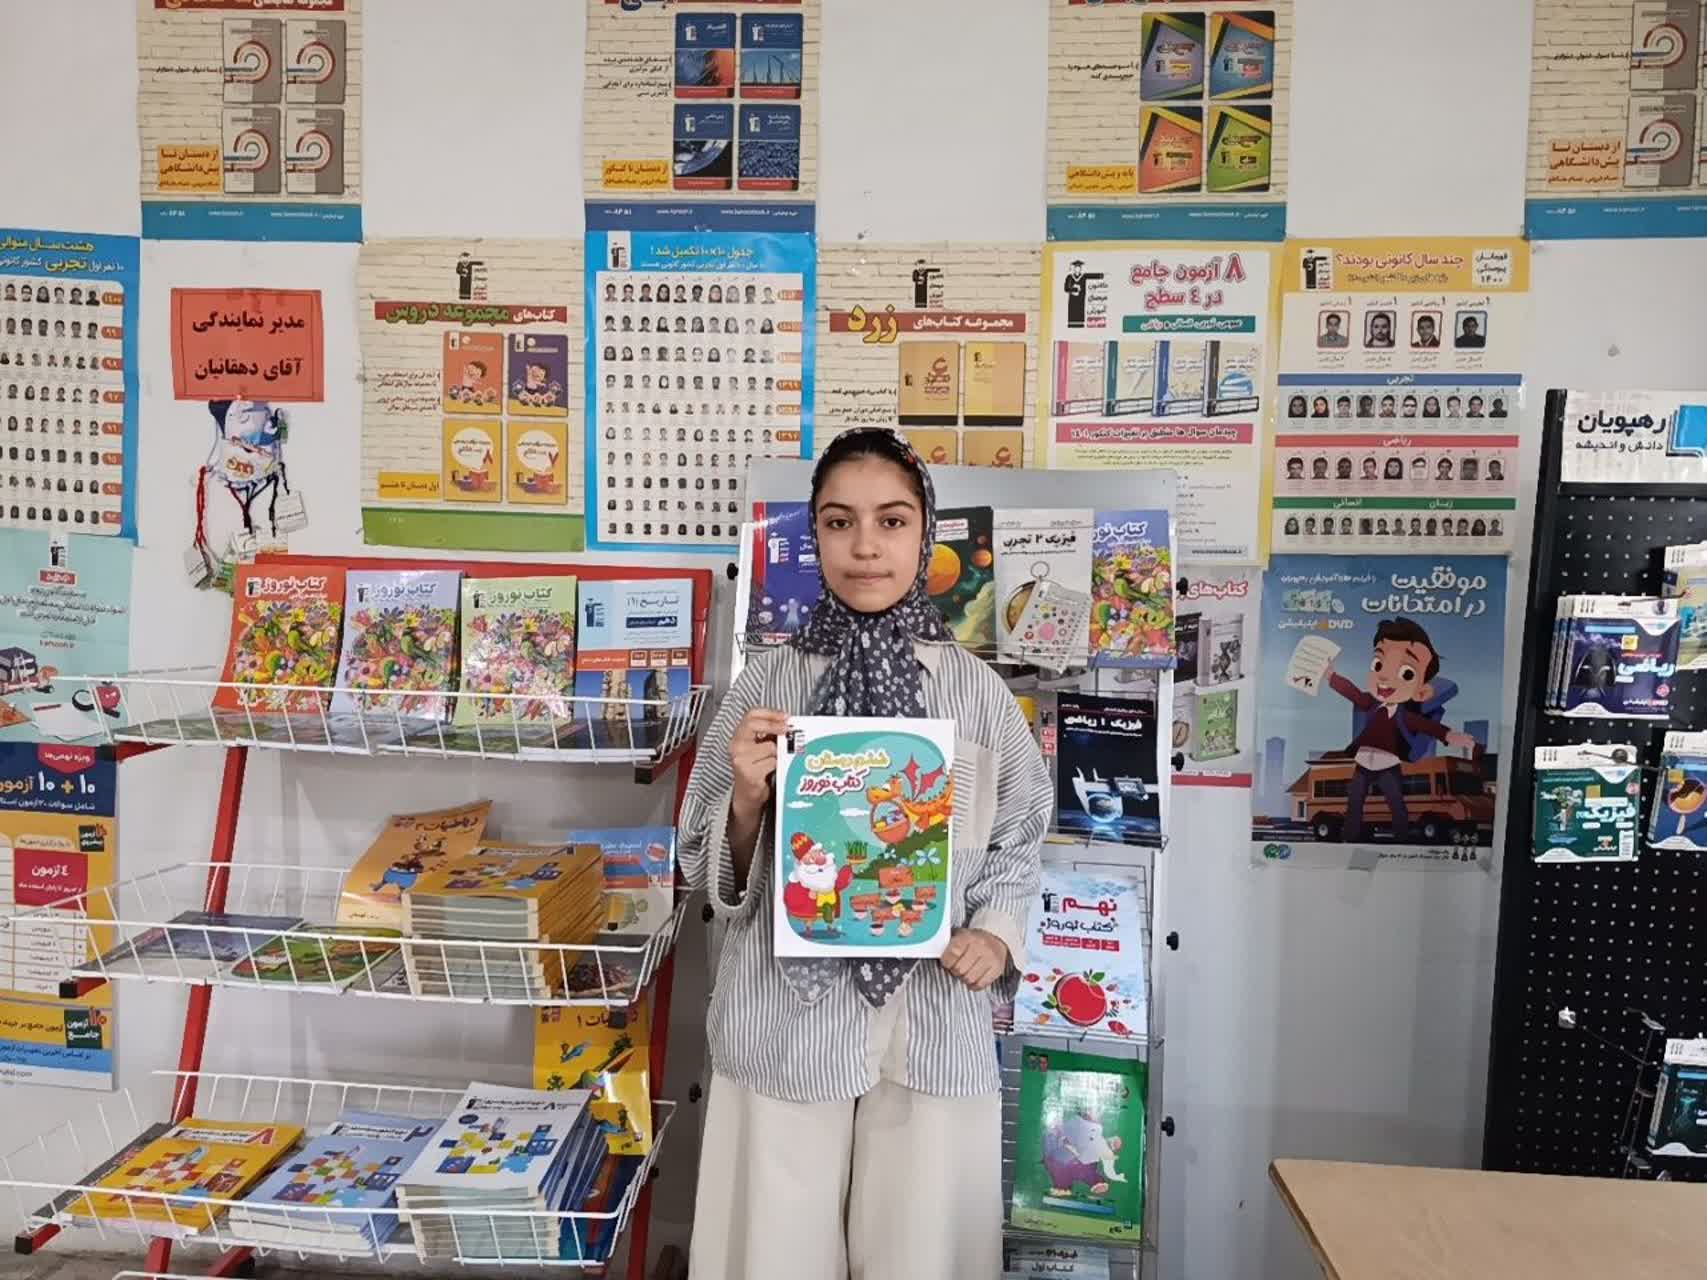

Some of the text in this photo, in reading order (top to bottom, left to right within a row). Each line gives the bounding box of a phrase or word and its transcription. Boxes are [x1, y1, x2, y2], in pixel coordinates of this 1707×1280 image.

[1415, 251, 1440, 269] سال
[1130, 259, 1170, 286] جامع
[1174, 257, 1222, 284] آزمون
[1143, 286, 1186, 311] سطح
[1202, 289, 1224, 310] در
[192, 310, 305, 335] مدیر نمایندگی
[847, 303, 899, 344] زرد
[194, 357, 304, 382] آقای دهقانیان
[1577, 409, 1667, 437] رهپویان
[1576, 440, 1664, 453] دانش و اندیشه
[1115, 521, 1148, 538] کتاب
[1002, 532, 1034, 550] تجربی
[1045, 530, 1077, 549] فیزیک
[261, 576, 327, 594] کتاب نوروز
[1391, 565, 1487, 596] موفقیت
[407, 582, 437, 599] کتاب
[489, 587, 553, 605] کتاب نوروز
[1361, 594, 1486, 618] در امتحانات
[1328, 619, 1354, 629] DVD
[1064, 715, 1097, 728] ریاضی
[1111, 719, 1143, 731] فیزیک
[799, 767, 868, 793] کتاب نوروز
[1045, 917, 1115, 934] کتاب نوروز
